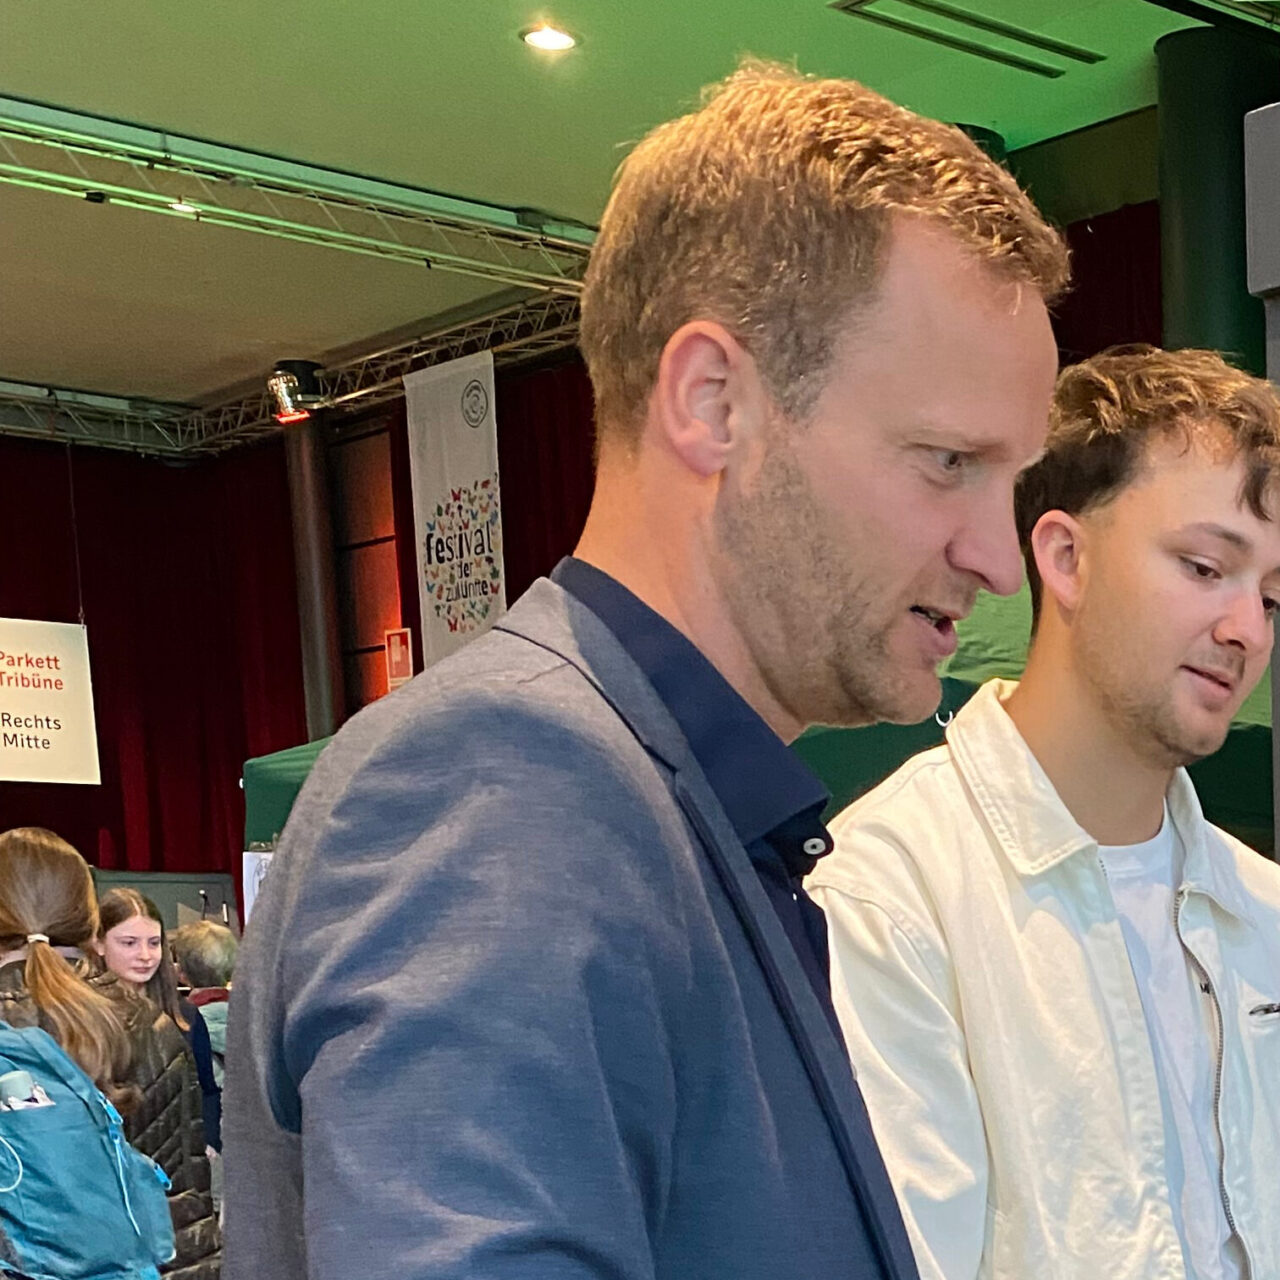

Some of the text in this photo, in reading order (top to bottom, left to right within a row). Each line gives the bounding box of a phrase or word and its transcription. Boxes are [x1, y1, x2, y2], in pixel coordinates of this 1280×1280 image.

[426, 521, 493, 564] festival
[457, 561, 473, 579] der
[0, 672, 63, 690] Tribüne
[1, 712, 61, 730] Rechts
[3, 733, 50, 749] Mitte
